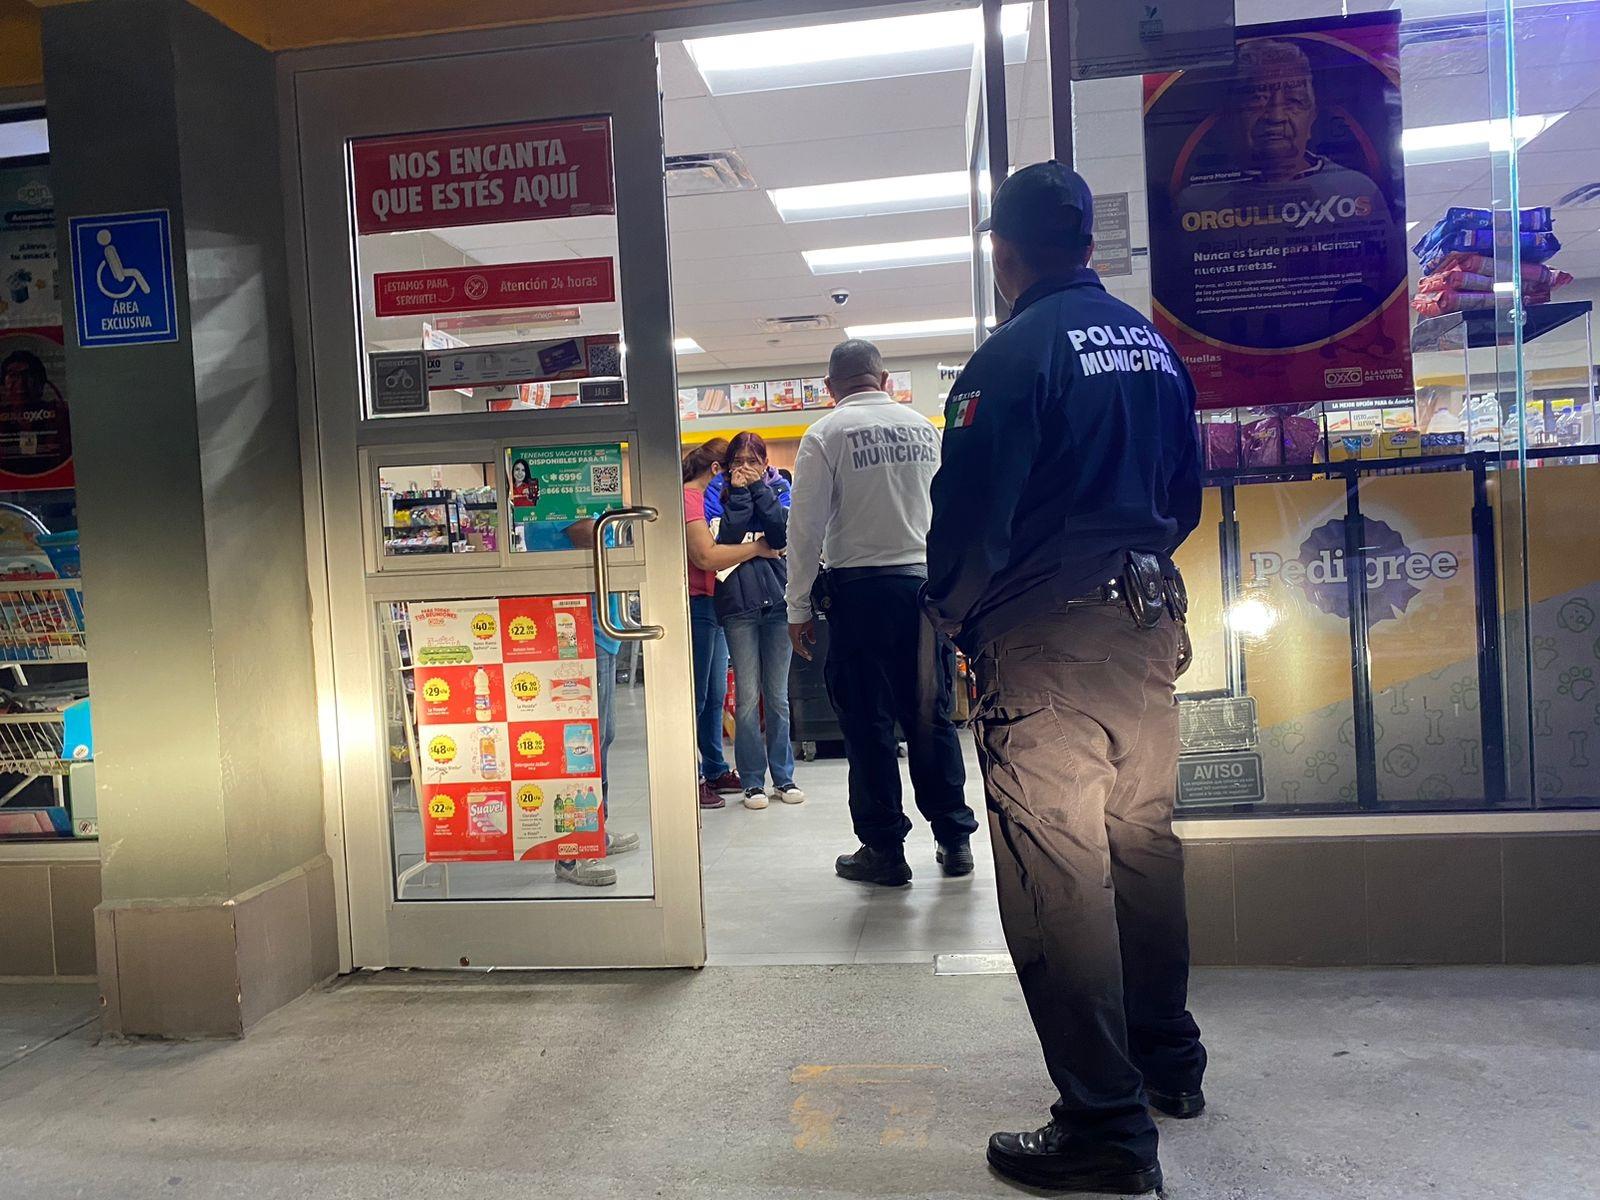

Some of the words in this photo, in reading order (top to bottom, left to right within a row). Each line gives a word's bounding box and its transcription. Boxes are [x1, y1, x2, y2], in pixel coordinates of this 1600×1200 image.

[388, 150, 441, 181] NOS
[449, 139, 566, 176] ENCANTA
[372, 185, 424, 222] QUE
[430, 174, 505, 211] ESTÉS
[512, 165, 582, 208] AQUÍ
[1193, 251, 1231, 262] Nunca
[1232, 250, 1246, 259] es
[1247, 246, 1280, 257] tarde
[1282, 244, 1309, 256] para
[1194, 265, 1235, 275] nuevas
[1237, 262, 1277, 272] metas.
[426, 278, 449, 289] PARA
[500, 277, 548, 292] Atención
[551, 277, 564, 289] 24
[567, 276, 598, 288] horas
[112, 299, 140, 315] ÁREA
[396, 294, 437, 306] SERVIRTE!
[101, 315, 153, 331] EXCLUSIVA
[1079, 349, 1178, 377] MUNICIPAL
[1181, 354, 1222, 364] Huellas
[1326, 369, 1361, 385] OXXO
[519, 450, 554, 459] TENEMOS
[555, 449, 593, 458] VACANTES
[528, 457, 577, 466] DISPONIBLES
[578, 456, 598, 464] PARA
[852, 444, 937, 470] MUNICIPAL
[1250, 548, 1459, 590] Pedigree
[1193, 763, 1243, 780] AVISO
[470, 801, 504, 817] Suavel
